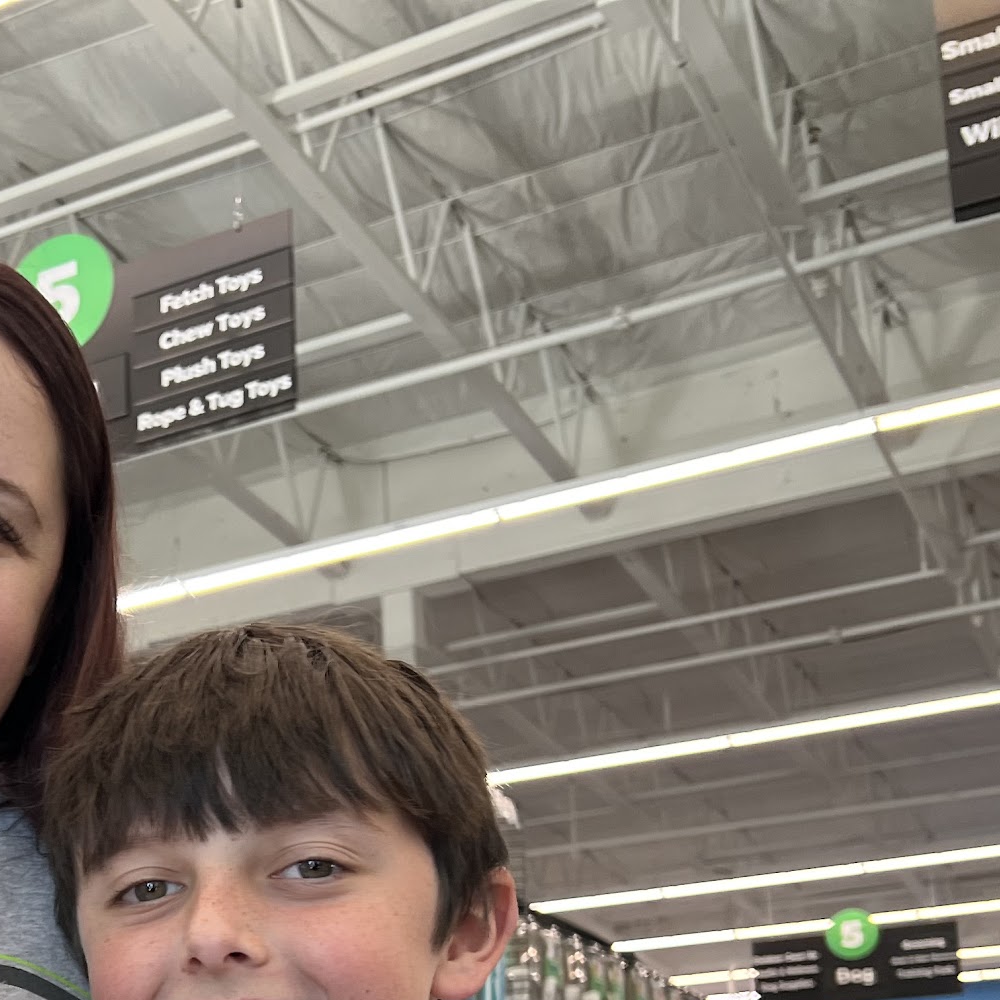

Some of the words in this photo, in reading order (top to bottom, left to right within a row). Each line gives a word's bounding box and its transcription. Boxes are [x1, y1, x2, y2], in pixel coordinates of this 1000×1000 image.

[36, 258, 81, 324] 5
[159, 281, 215, 314] Fetch
[214, 267, 264, 294] Toys
[158, 320, 215, 350] Chew
[215, 304, 267, 332] Toys
[160, 355, 217, 388] Plush
[216, 343, 266, 370] Toys
[136, 404, 187, 432] Rope
[187, 396, 206, 417] &
[205, 388, 245, 411] Tug
[244, 373, 293, 400] Toys
[839, 918, 865, 949] 5
[834, 966, 876, 987] Dog
